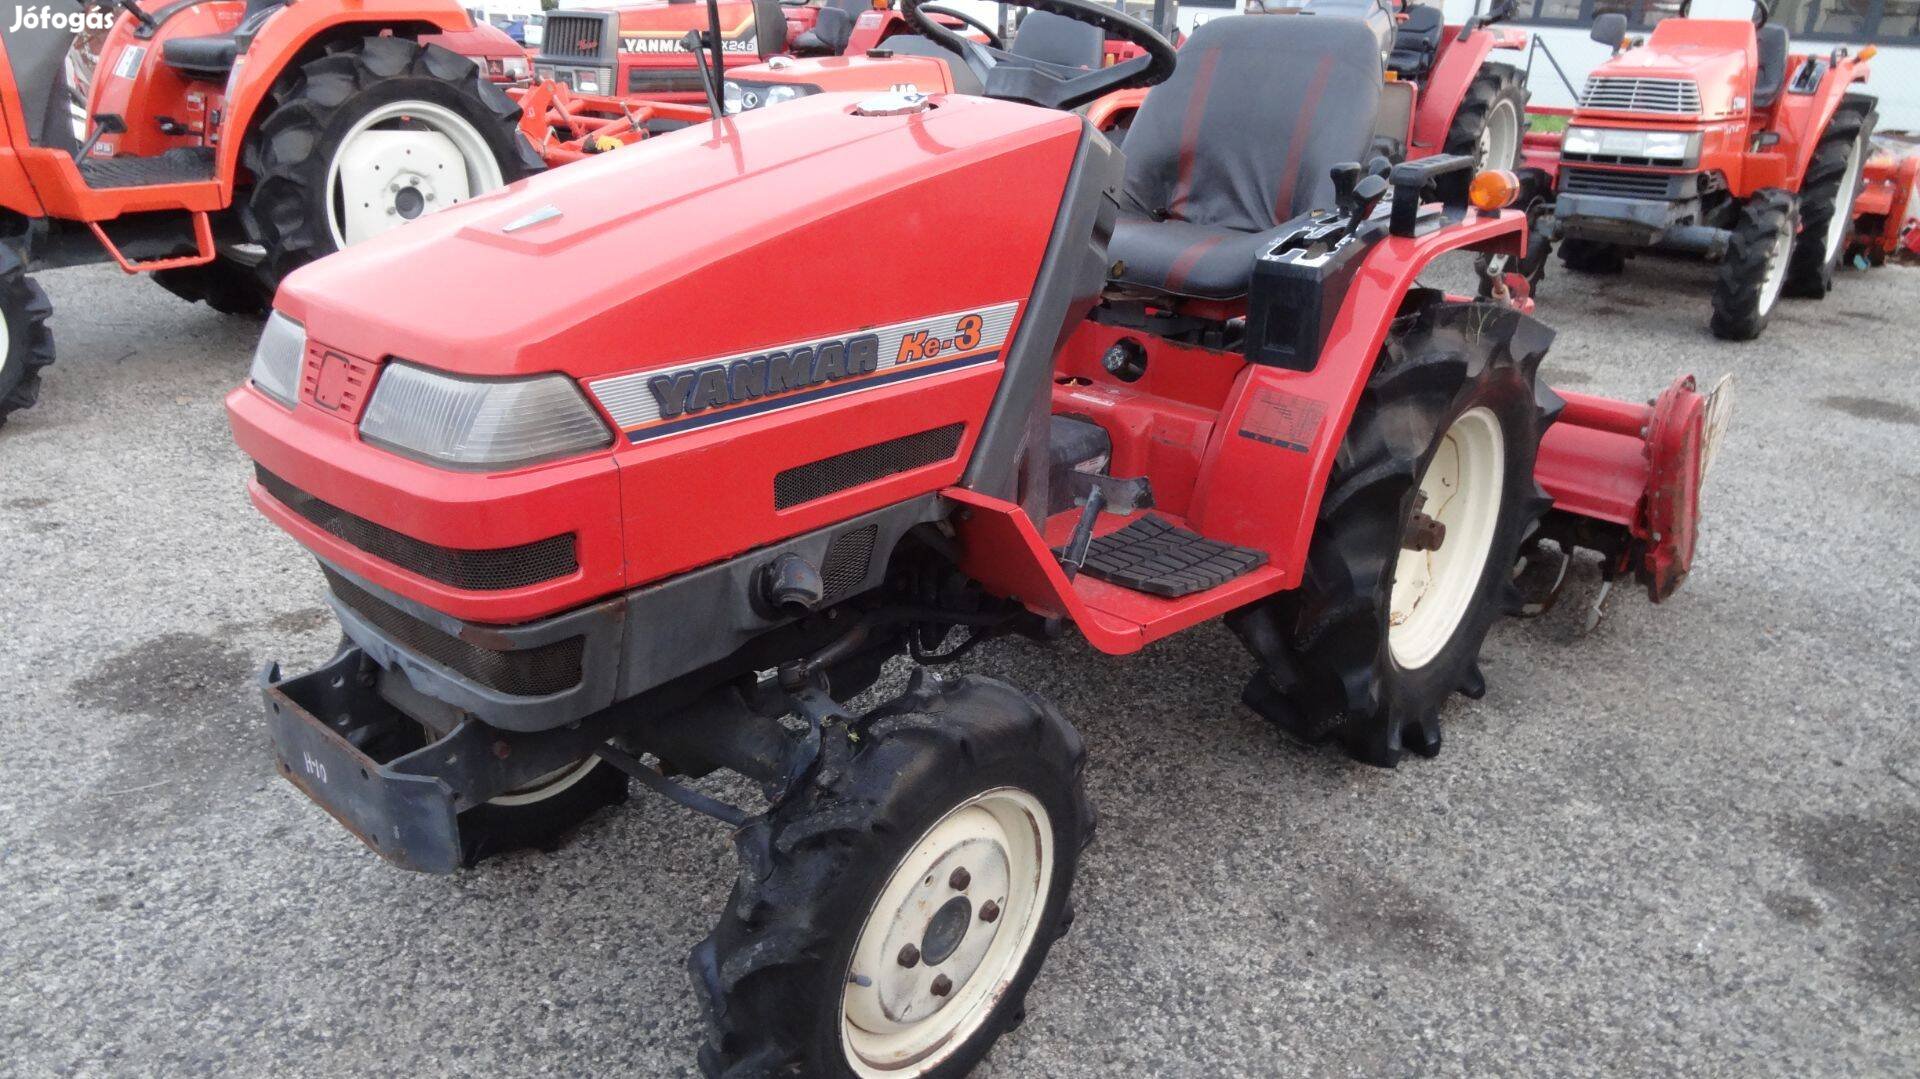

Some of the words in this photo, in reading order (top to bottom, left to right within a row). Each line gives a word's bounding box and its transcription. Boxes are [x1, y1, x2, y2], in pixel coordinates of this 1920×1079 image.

[624, 38, 690, 52] YANMA
[648, 334, 879, 419] YANMAR
[896, 315, 984, 364] Ke-3
